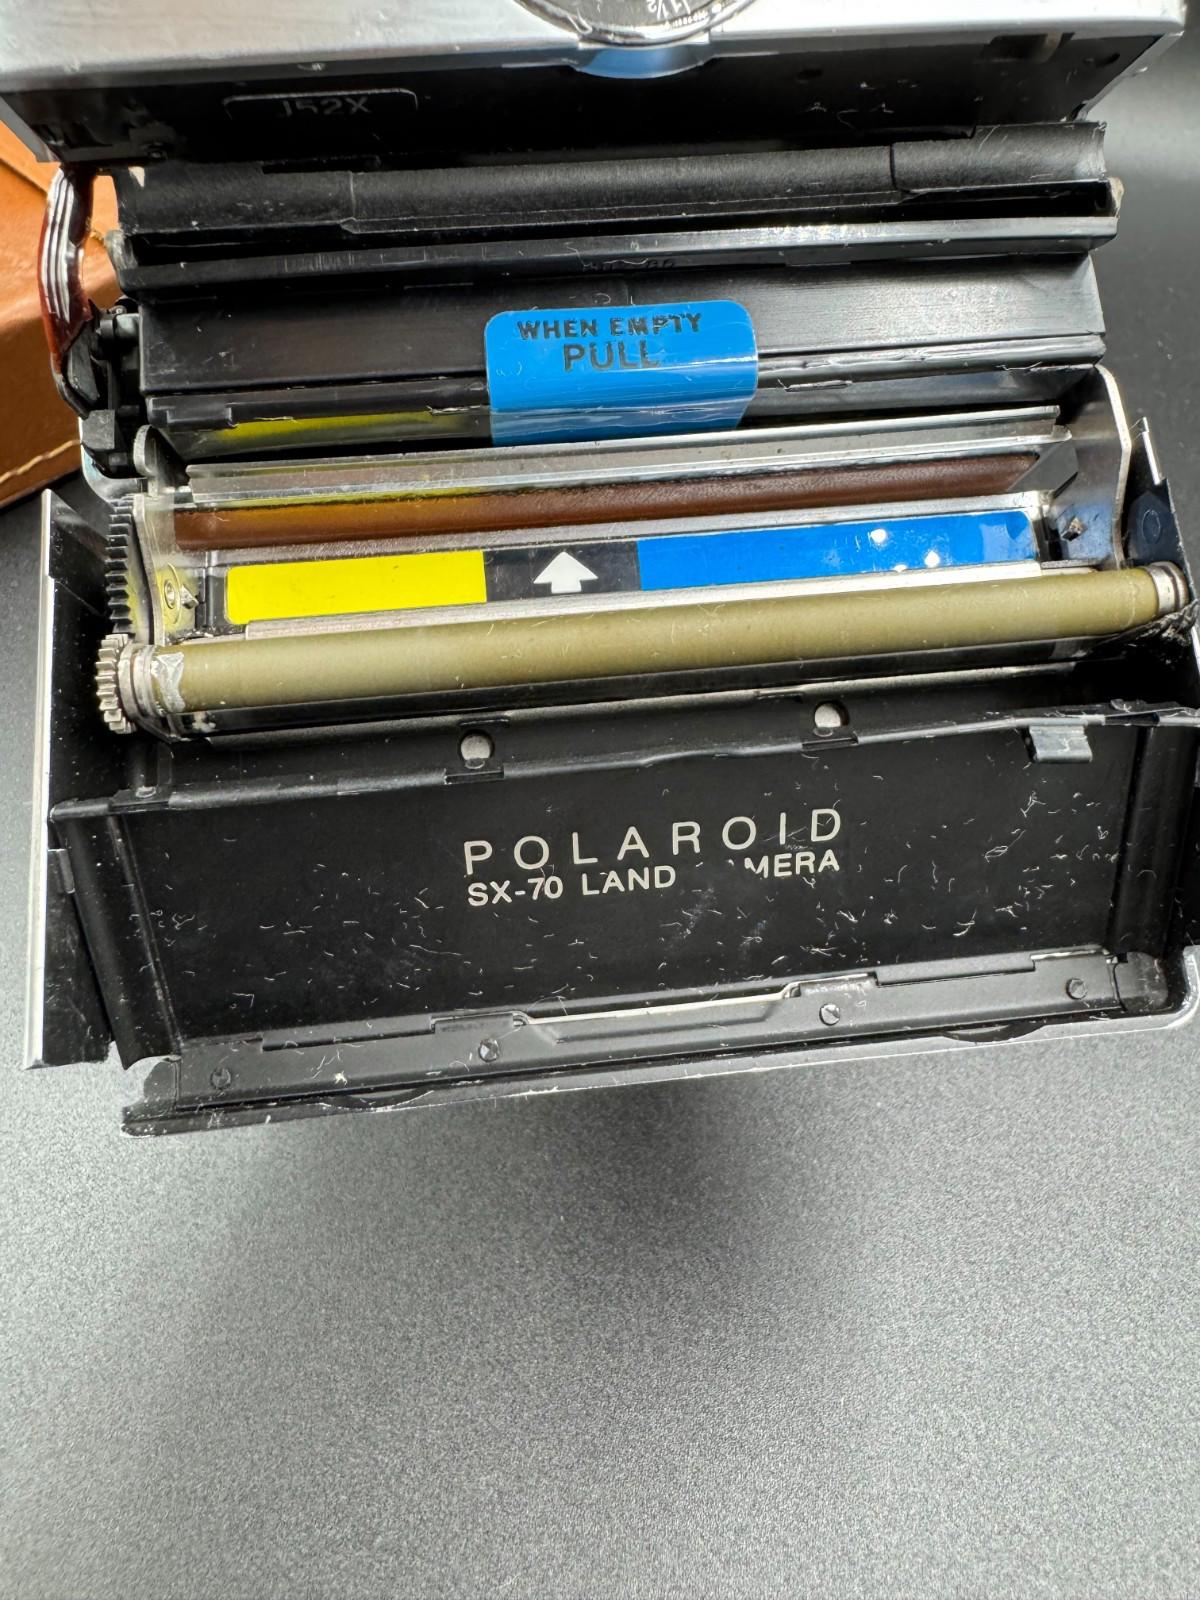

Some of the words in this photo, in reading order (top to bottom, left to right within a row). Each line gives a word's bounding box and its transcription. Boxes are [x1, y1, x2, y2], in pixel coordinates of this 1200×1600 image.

[517, 318, 599, 341] WHEN
[610, 312, 701, 337] EMPTY
[562, 339, 661, 373] PULL
[463, 808, 841, 875] POLAROID
[467, 875, 563, 907] SX-70
[582, 865, 677, 896] LAND
[726, 848, 841, 879] MERA
